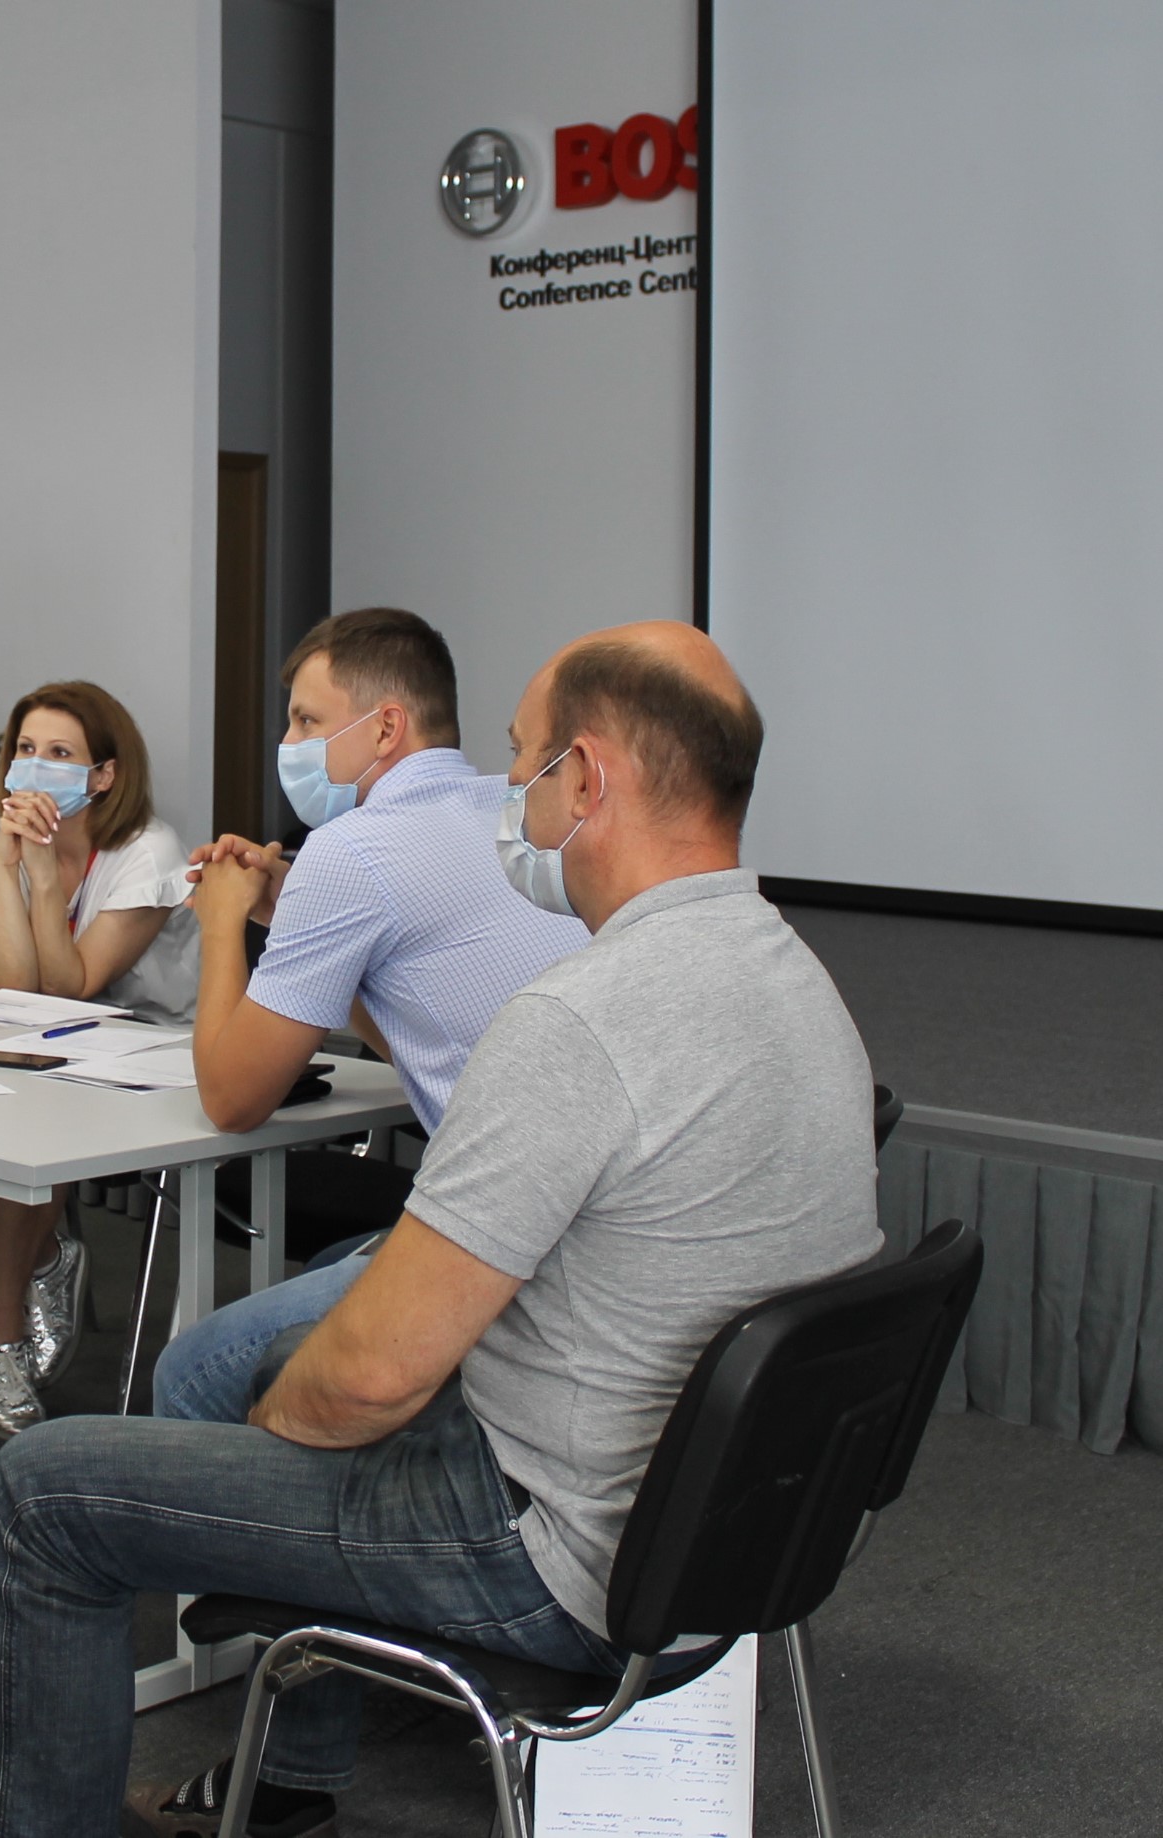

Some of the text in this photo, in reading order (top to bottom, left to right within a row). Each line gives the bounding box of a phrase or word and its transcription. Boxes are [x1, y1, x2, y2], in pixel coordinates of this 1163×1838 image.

[490, 235, 698, 279] Конференц-Цент
[499, 267, 698, 311] Conference Cent
